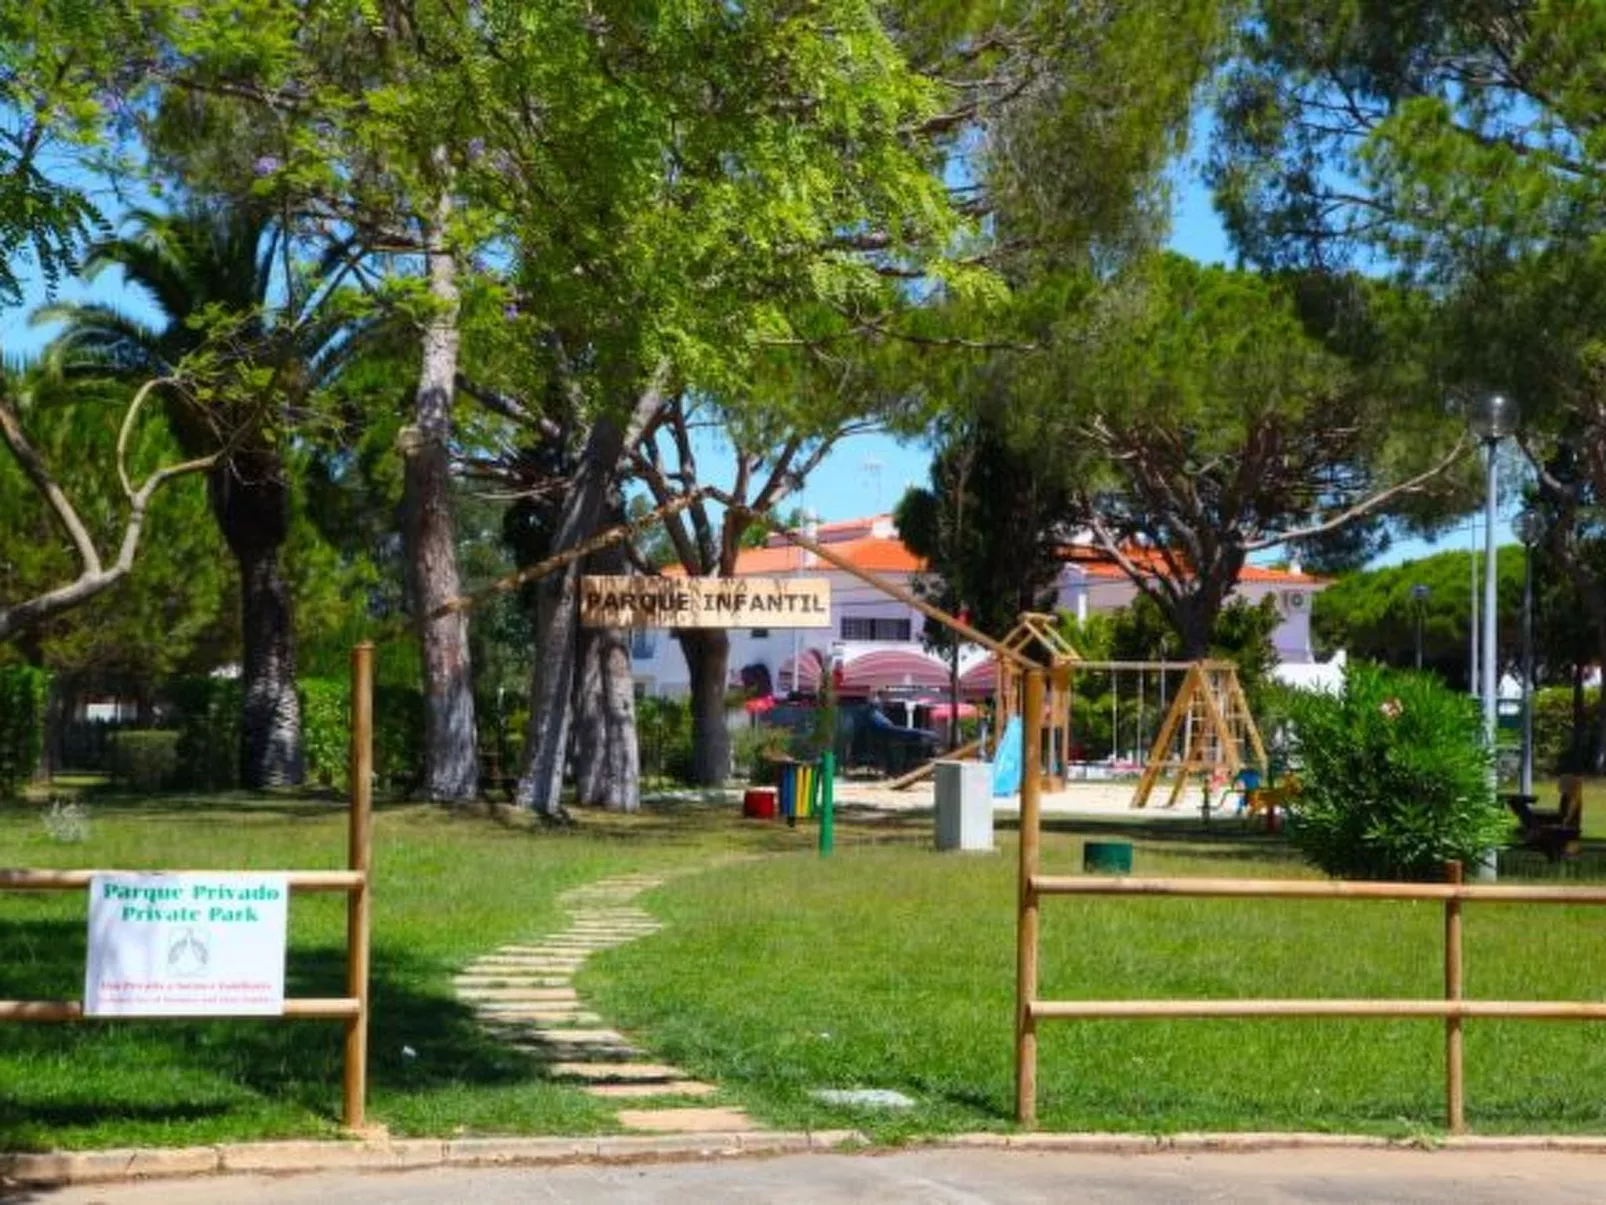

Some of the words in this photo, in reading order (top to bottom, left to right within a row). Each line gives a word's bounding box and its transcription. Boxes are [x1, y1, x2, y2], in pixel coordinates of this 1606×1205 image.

[586, 591, 690, 613] PARQUE
[703, 593, 827, 613] INFANTIL
[104, 883, 182, 903] Parque
[193, 884, 280, 901] Privado
[122, 906, 201, 922] Private
[208, 906, 259, 922] Park
